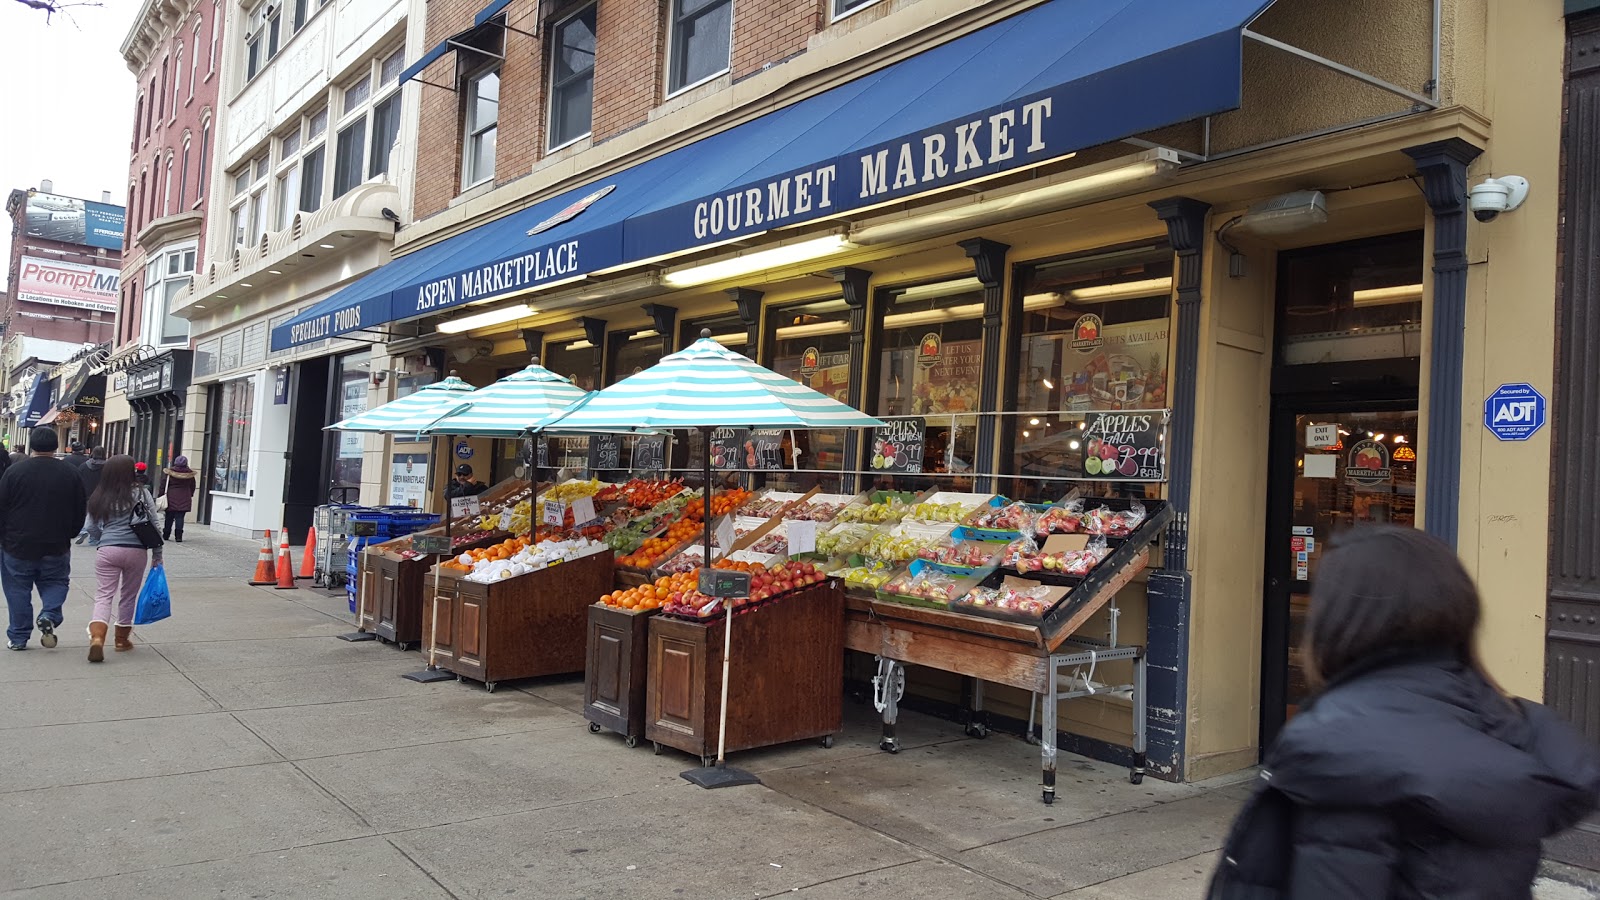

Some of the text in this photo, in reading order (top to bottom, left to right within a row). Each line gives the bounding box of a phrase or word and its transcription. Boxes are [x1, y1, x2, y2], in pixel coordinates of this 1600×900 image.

[694, 97, 1052, 239] GOURMET MARKET
[416, 240, 579, 310] ASPEN MARKETPLACE
[26, 295, 52, 303] Locations
[61, 299, 84, 307] Hoboken
[290, 305, 361, 344] SPECIALTY FOODS
[946, 345, 972, 354] LET US
[833, 354, 849, 364] CAR
[935, 368, 955, 376] NEXT
[1494, 402, 1535, 422] ADT
[1094, 415, 1152, 433] APPLES
[1357, 442, 1383, 452] ASPEN
[1140, 468, 1161, 479] BAG
